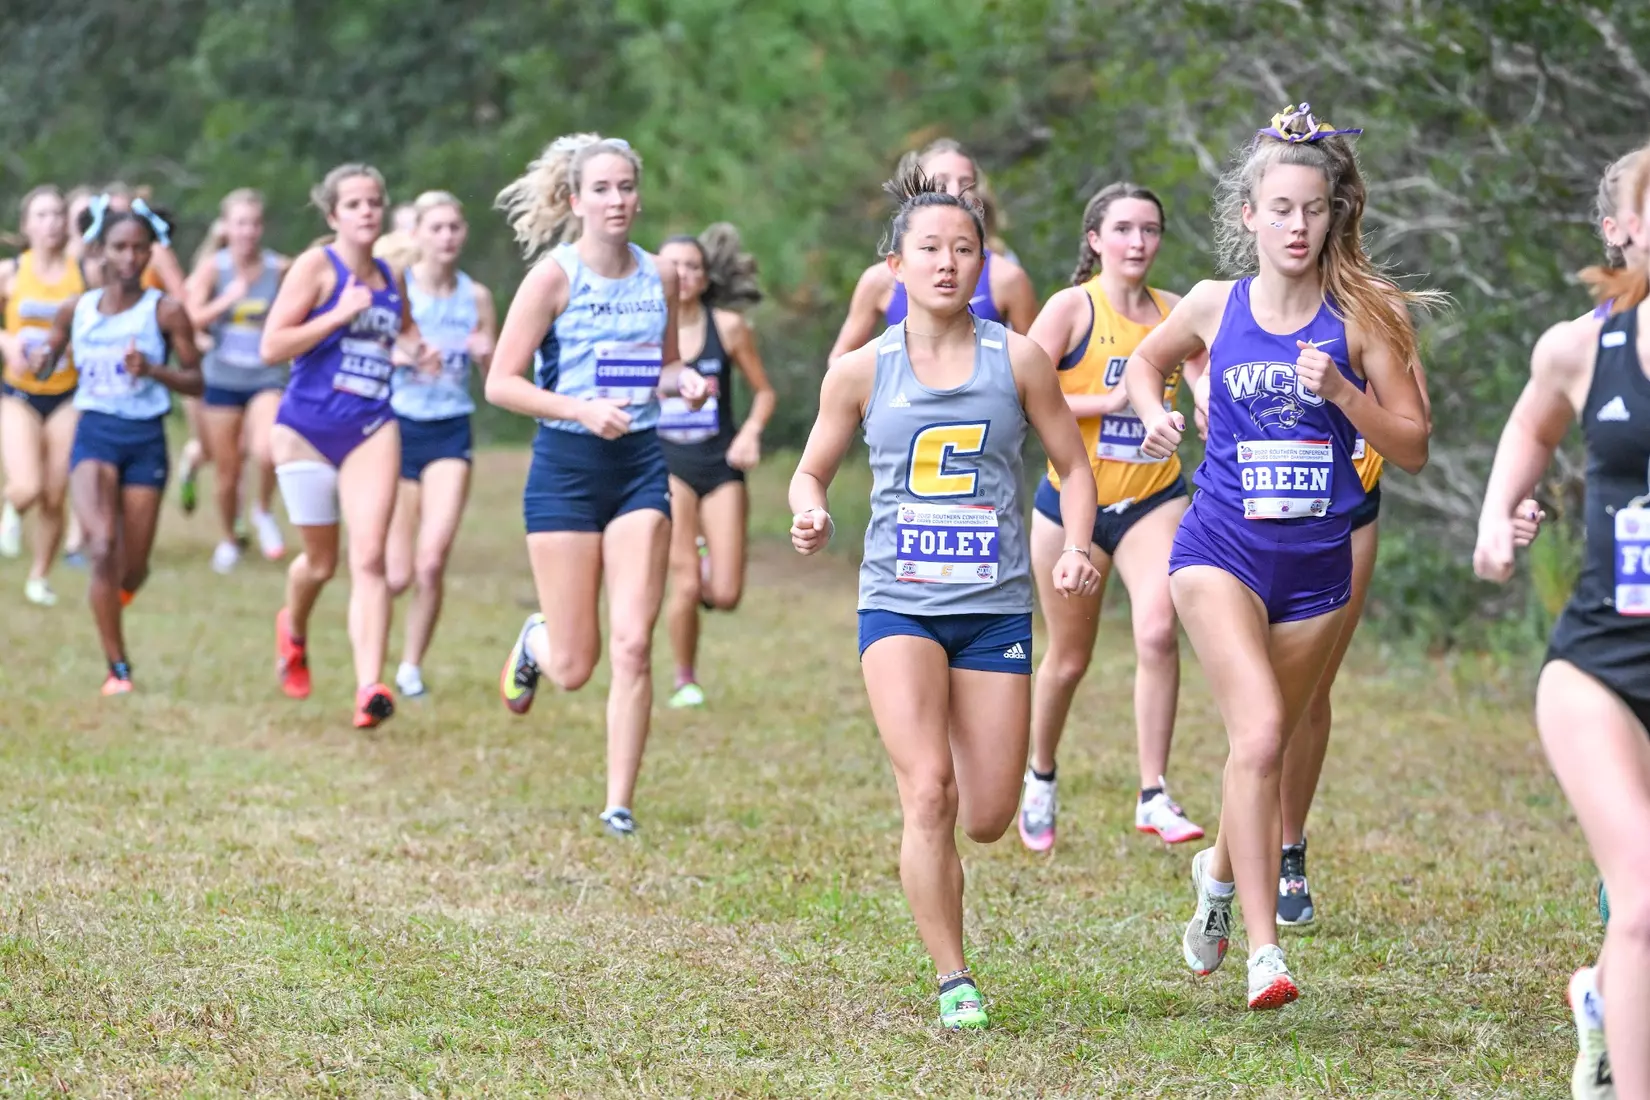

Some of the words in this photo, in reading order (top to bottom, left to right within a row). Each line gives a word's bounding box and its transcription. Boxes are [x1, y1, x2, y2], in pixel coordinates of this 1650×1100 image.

[905, 419, 991, 500] C
[1242, 466, 1329, 491] GREEN
[901, 529, 996, 556] FOLEY
